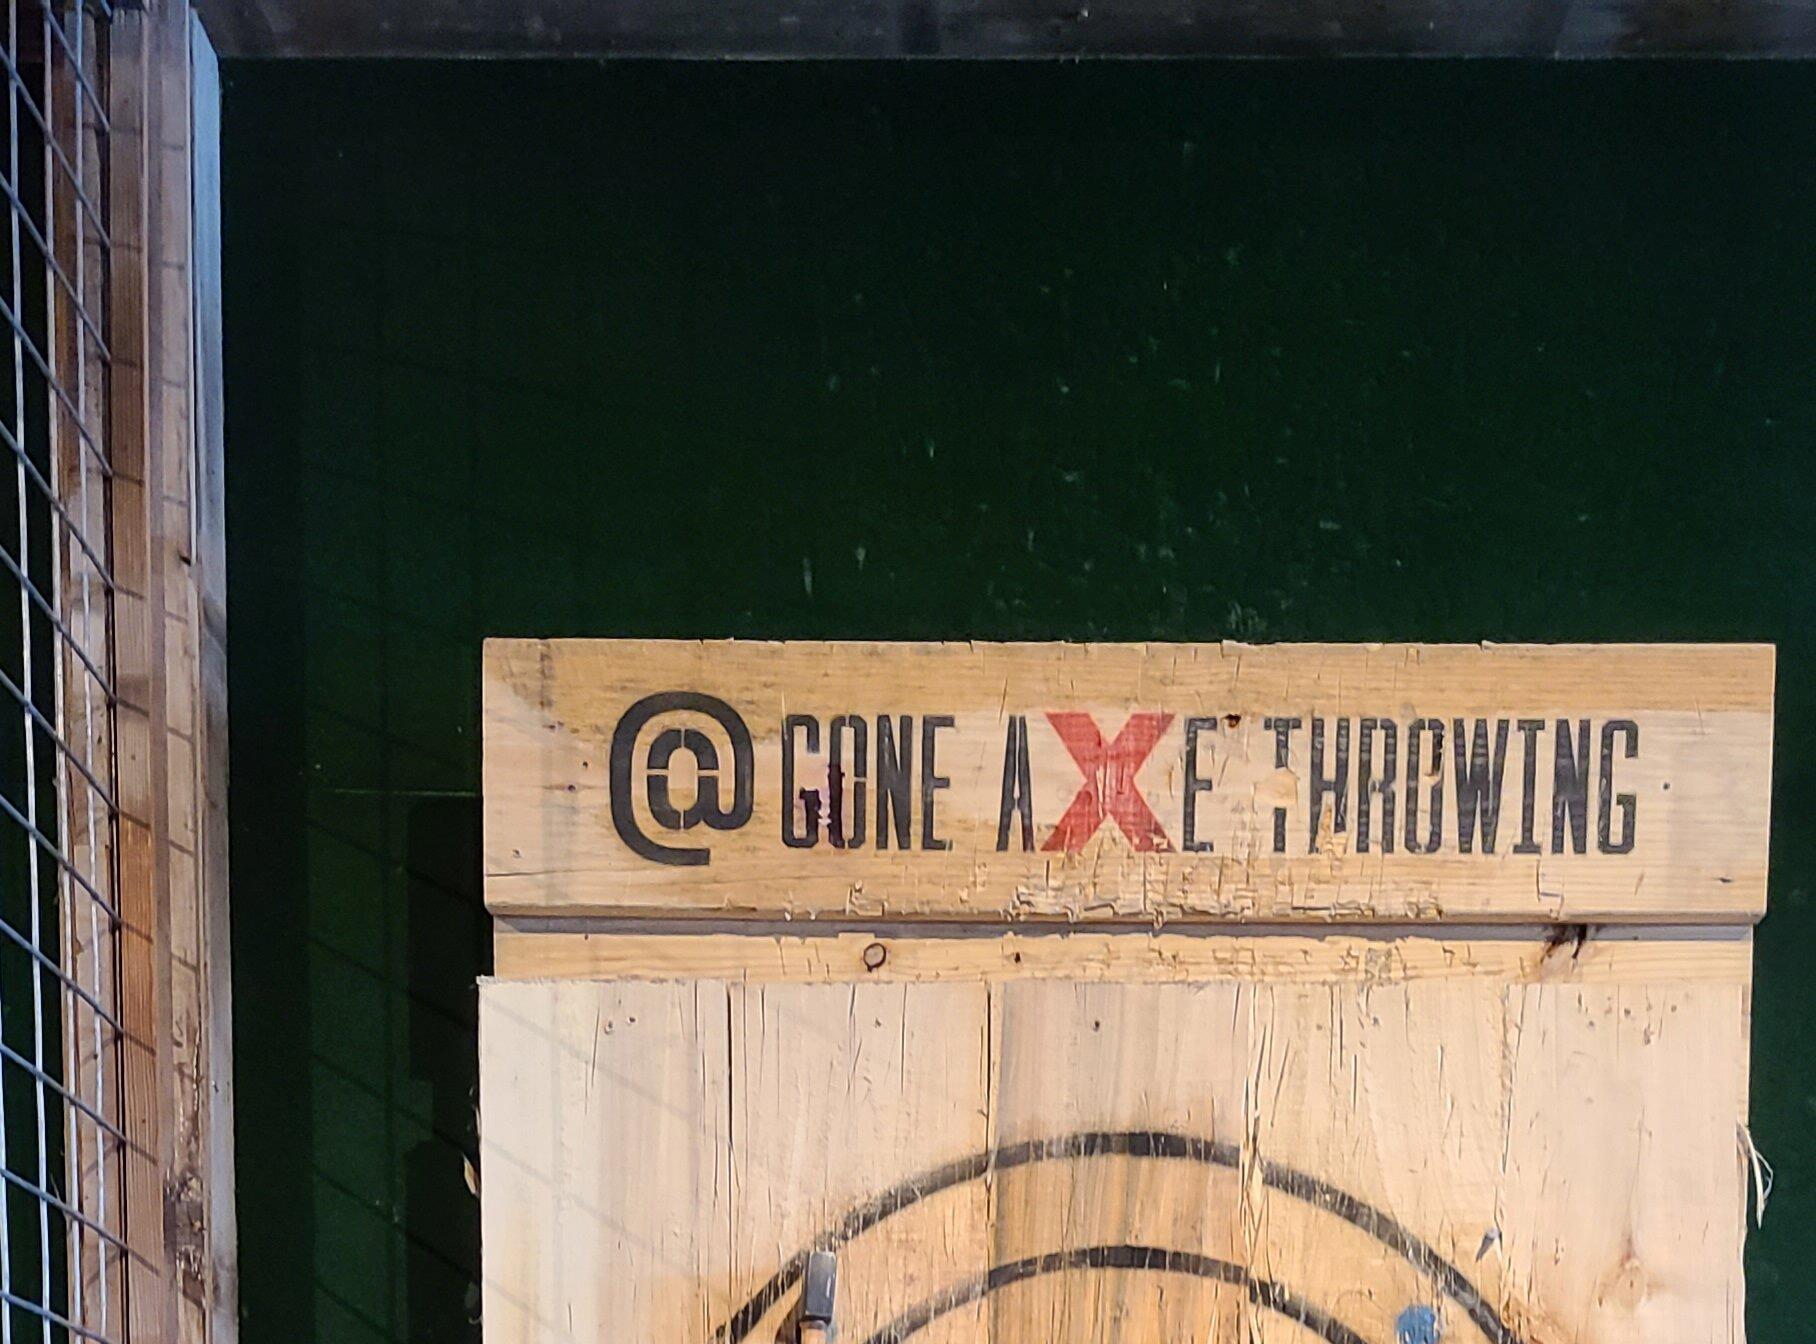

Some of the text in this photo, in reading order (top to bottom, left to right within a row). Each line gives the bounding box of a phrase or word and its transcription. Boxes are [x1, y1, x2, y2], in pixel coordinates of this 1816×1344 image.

[782, 714, 954, 850] GONE
[995, 712, 1217, 853] AXE
[1264, 716, 1639, 854] THROWING
